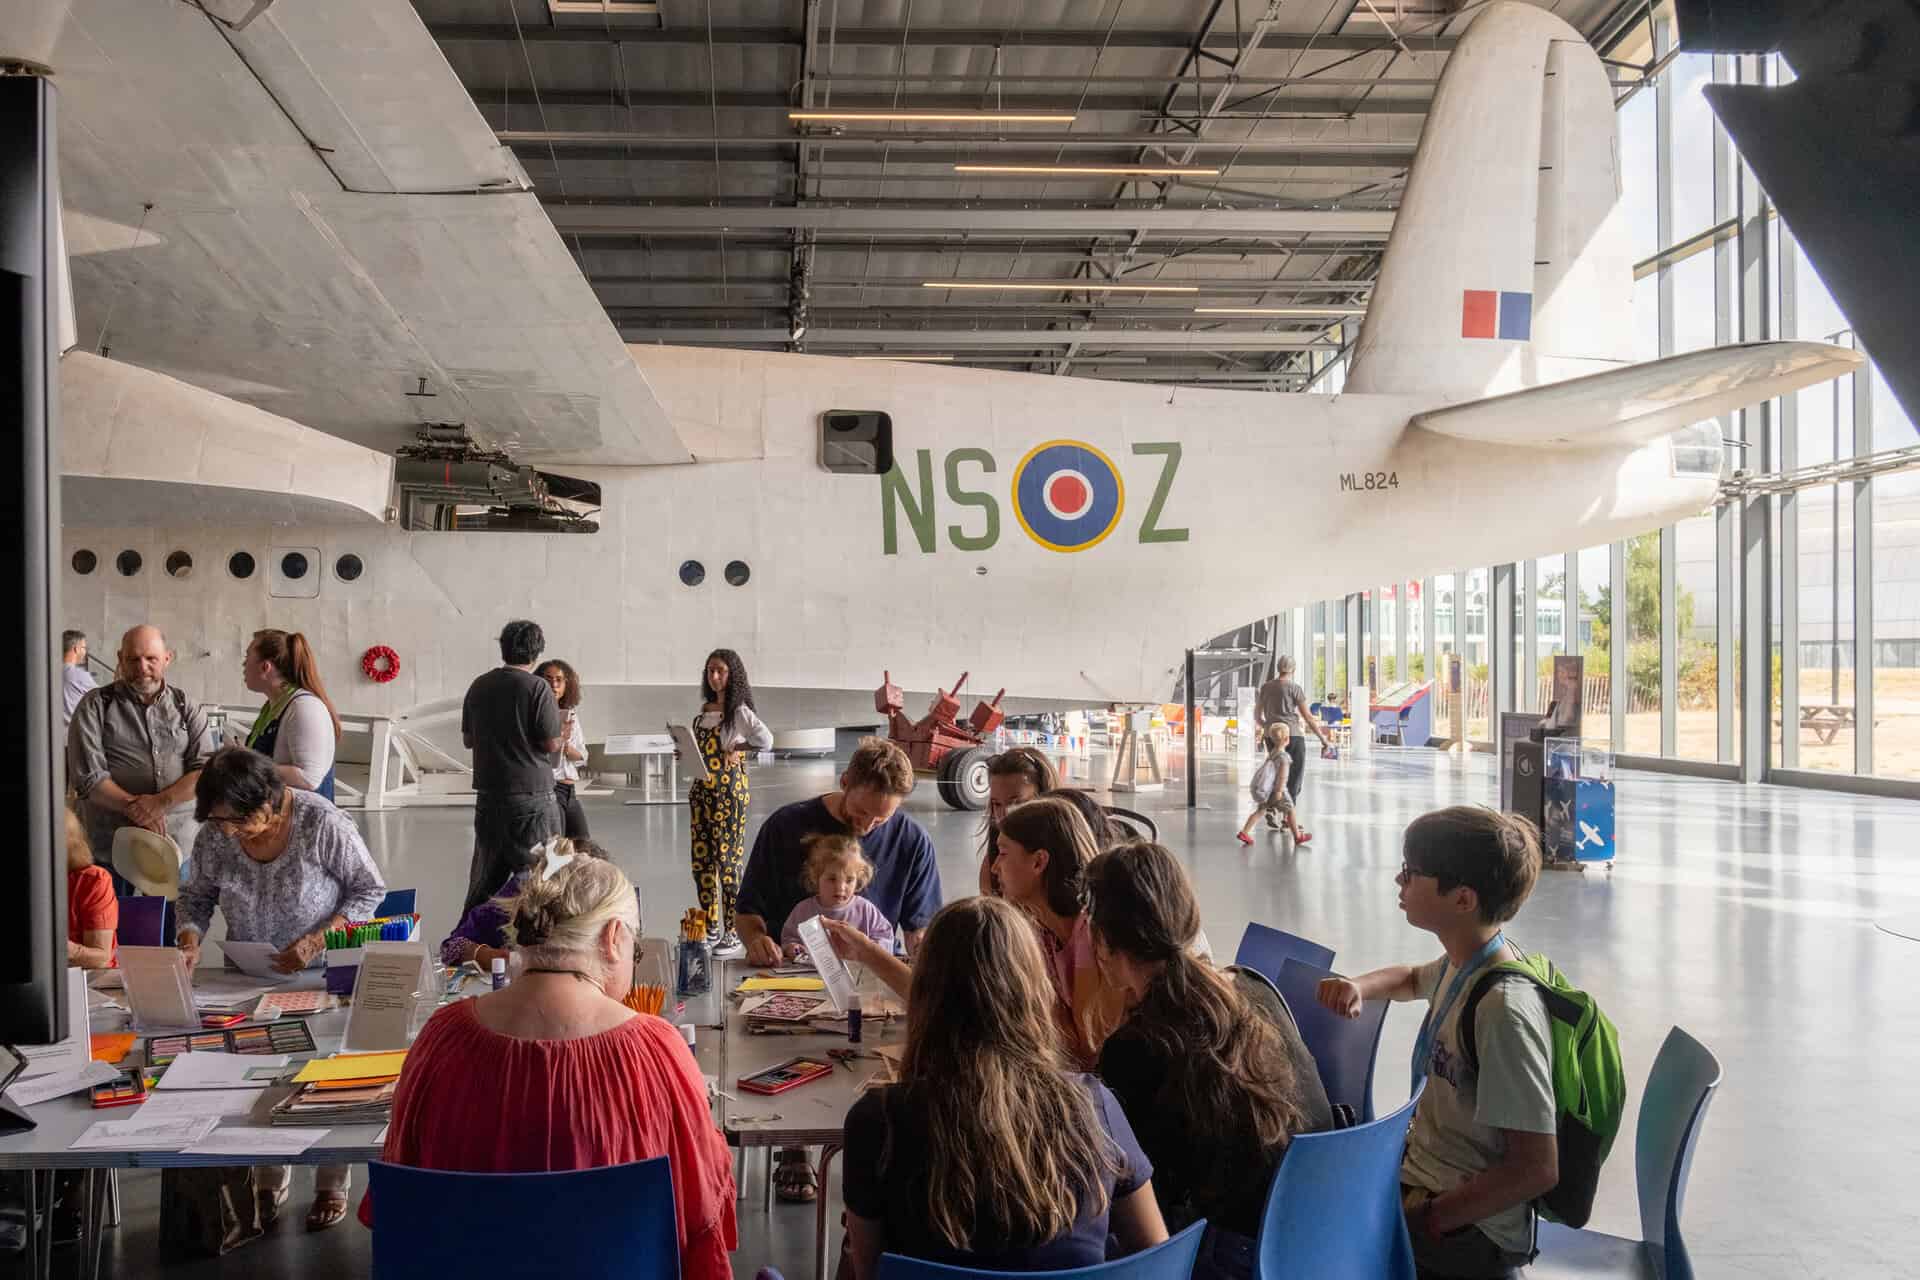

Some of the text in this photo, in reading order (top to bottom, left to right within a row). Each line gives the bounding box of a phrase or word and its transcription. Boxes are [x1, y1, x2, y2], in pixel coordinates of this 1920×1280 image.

[880, 441, 1190, 555] NS Z
[1339, 471, 1400, 491] ML824
